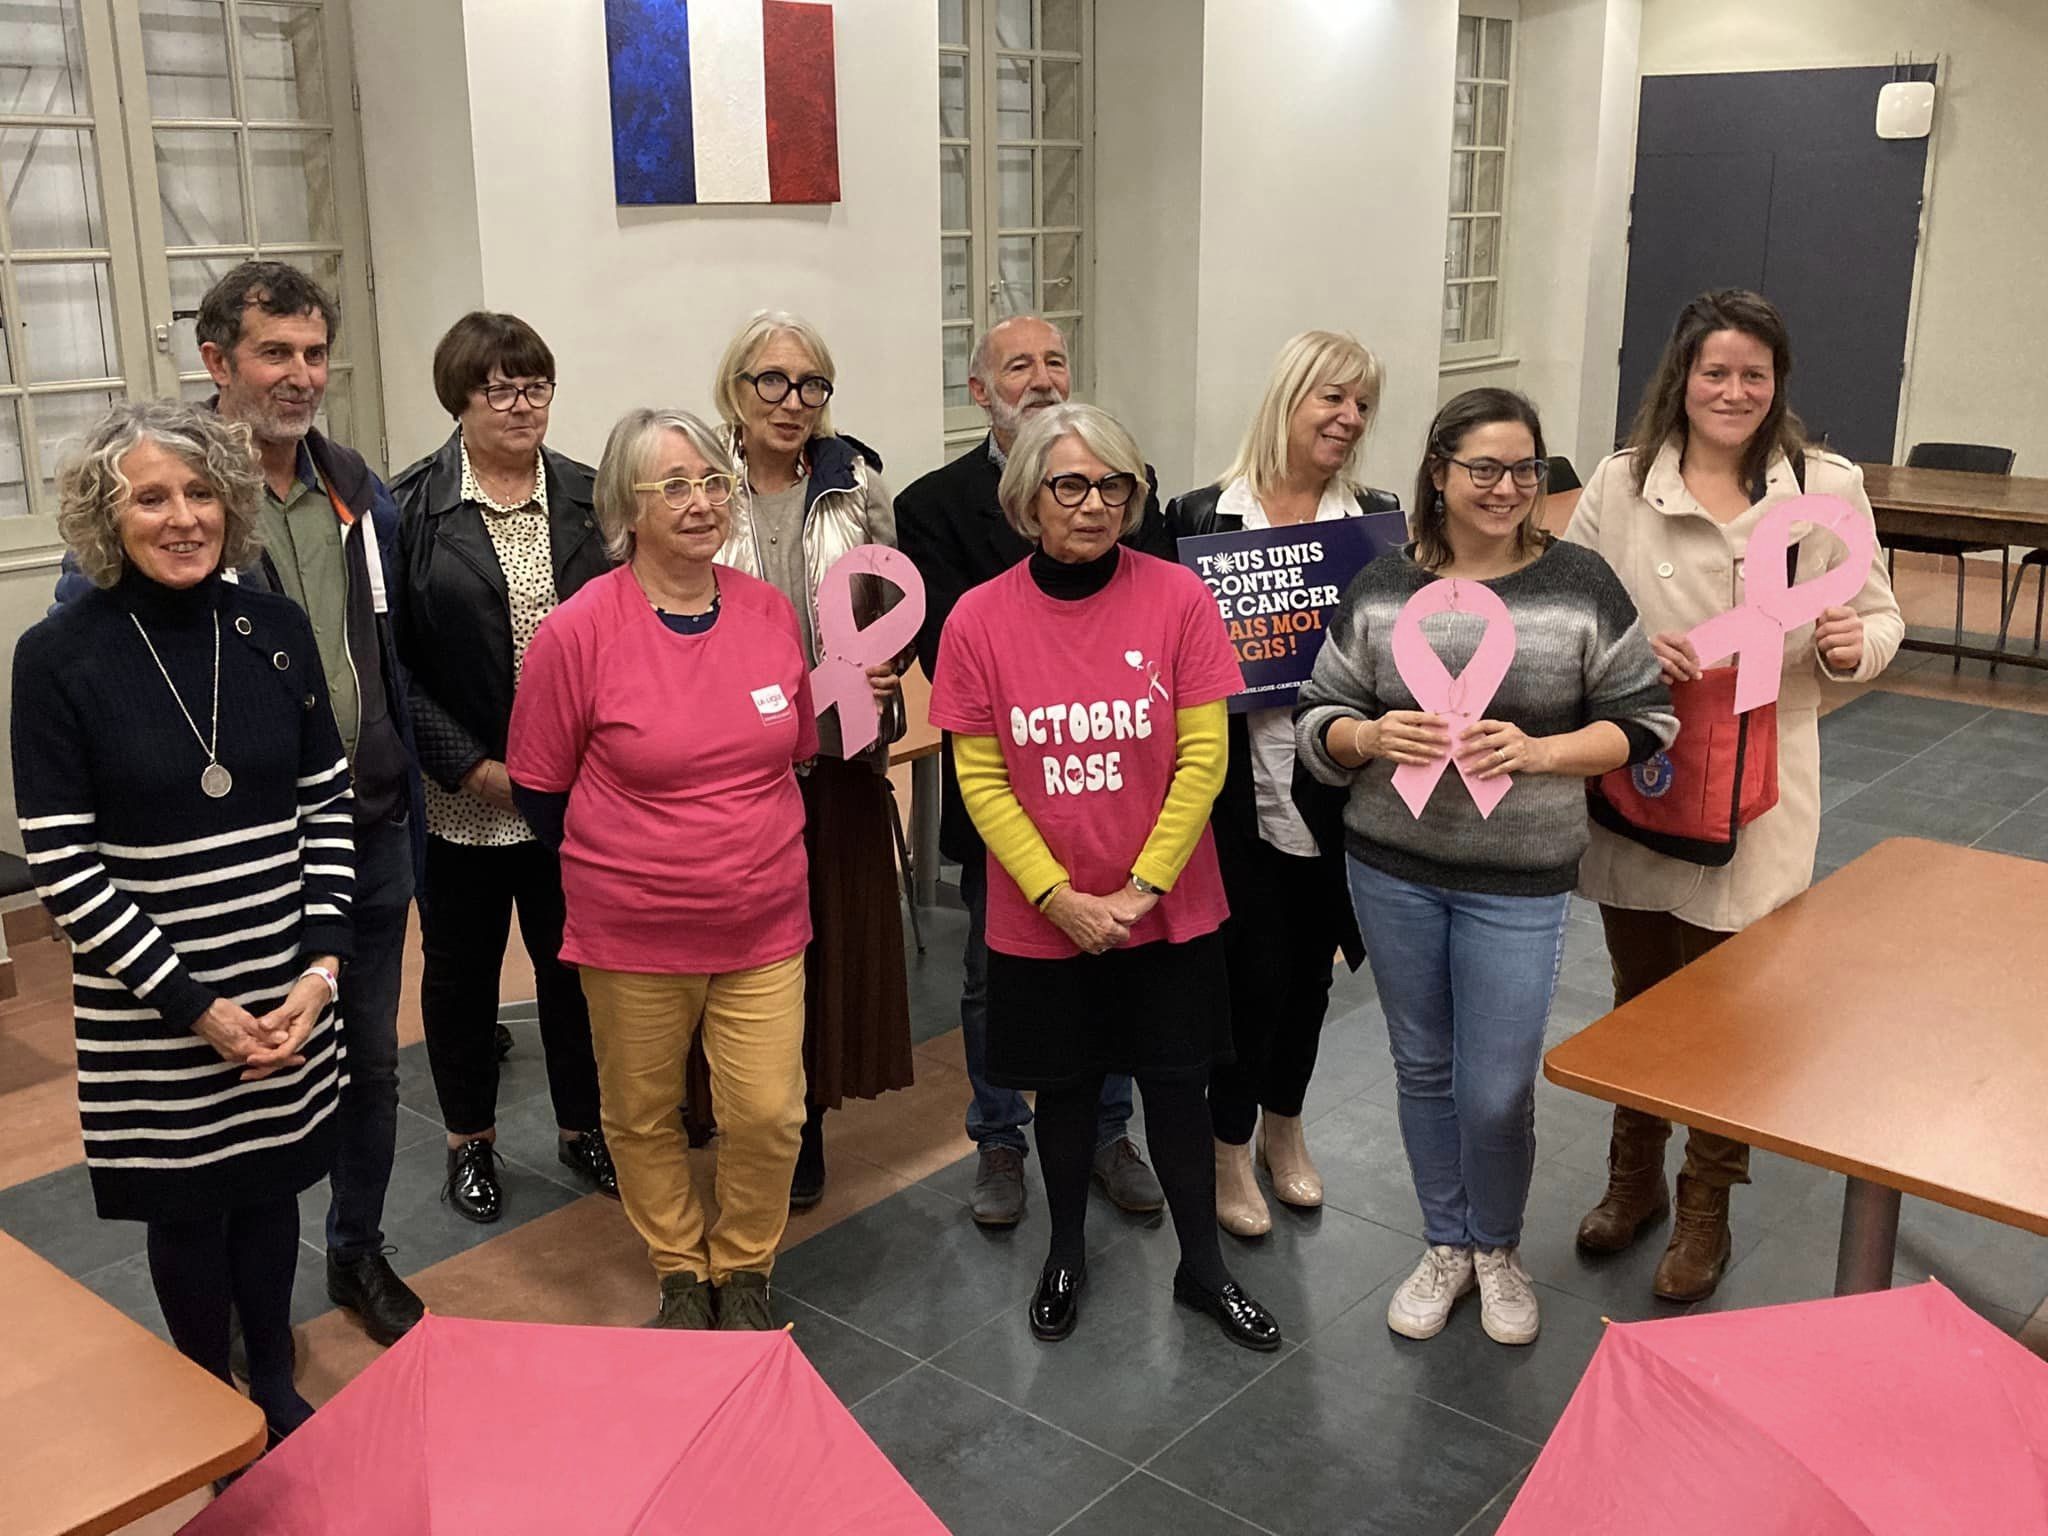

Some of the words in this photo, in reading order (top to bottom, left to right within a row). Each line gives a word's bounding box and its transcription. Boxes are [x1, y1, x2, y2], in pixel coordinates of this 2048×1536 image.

[1266, 541, 1324, 567] UNIS
[1217, 599, 1233, 619] E
[1236, 584, 1340, 616] CANCER
[1229, 617, 1268, 640] AIS
[1271, 610, 1322, 635] MOI
[1010, 698, 1152, 747] OCTOBRE
[1042, 752, 1124, 796] ROSE
